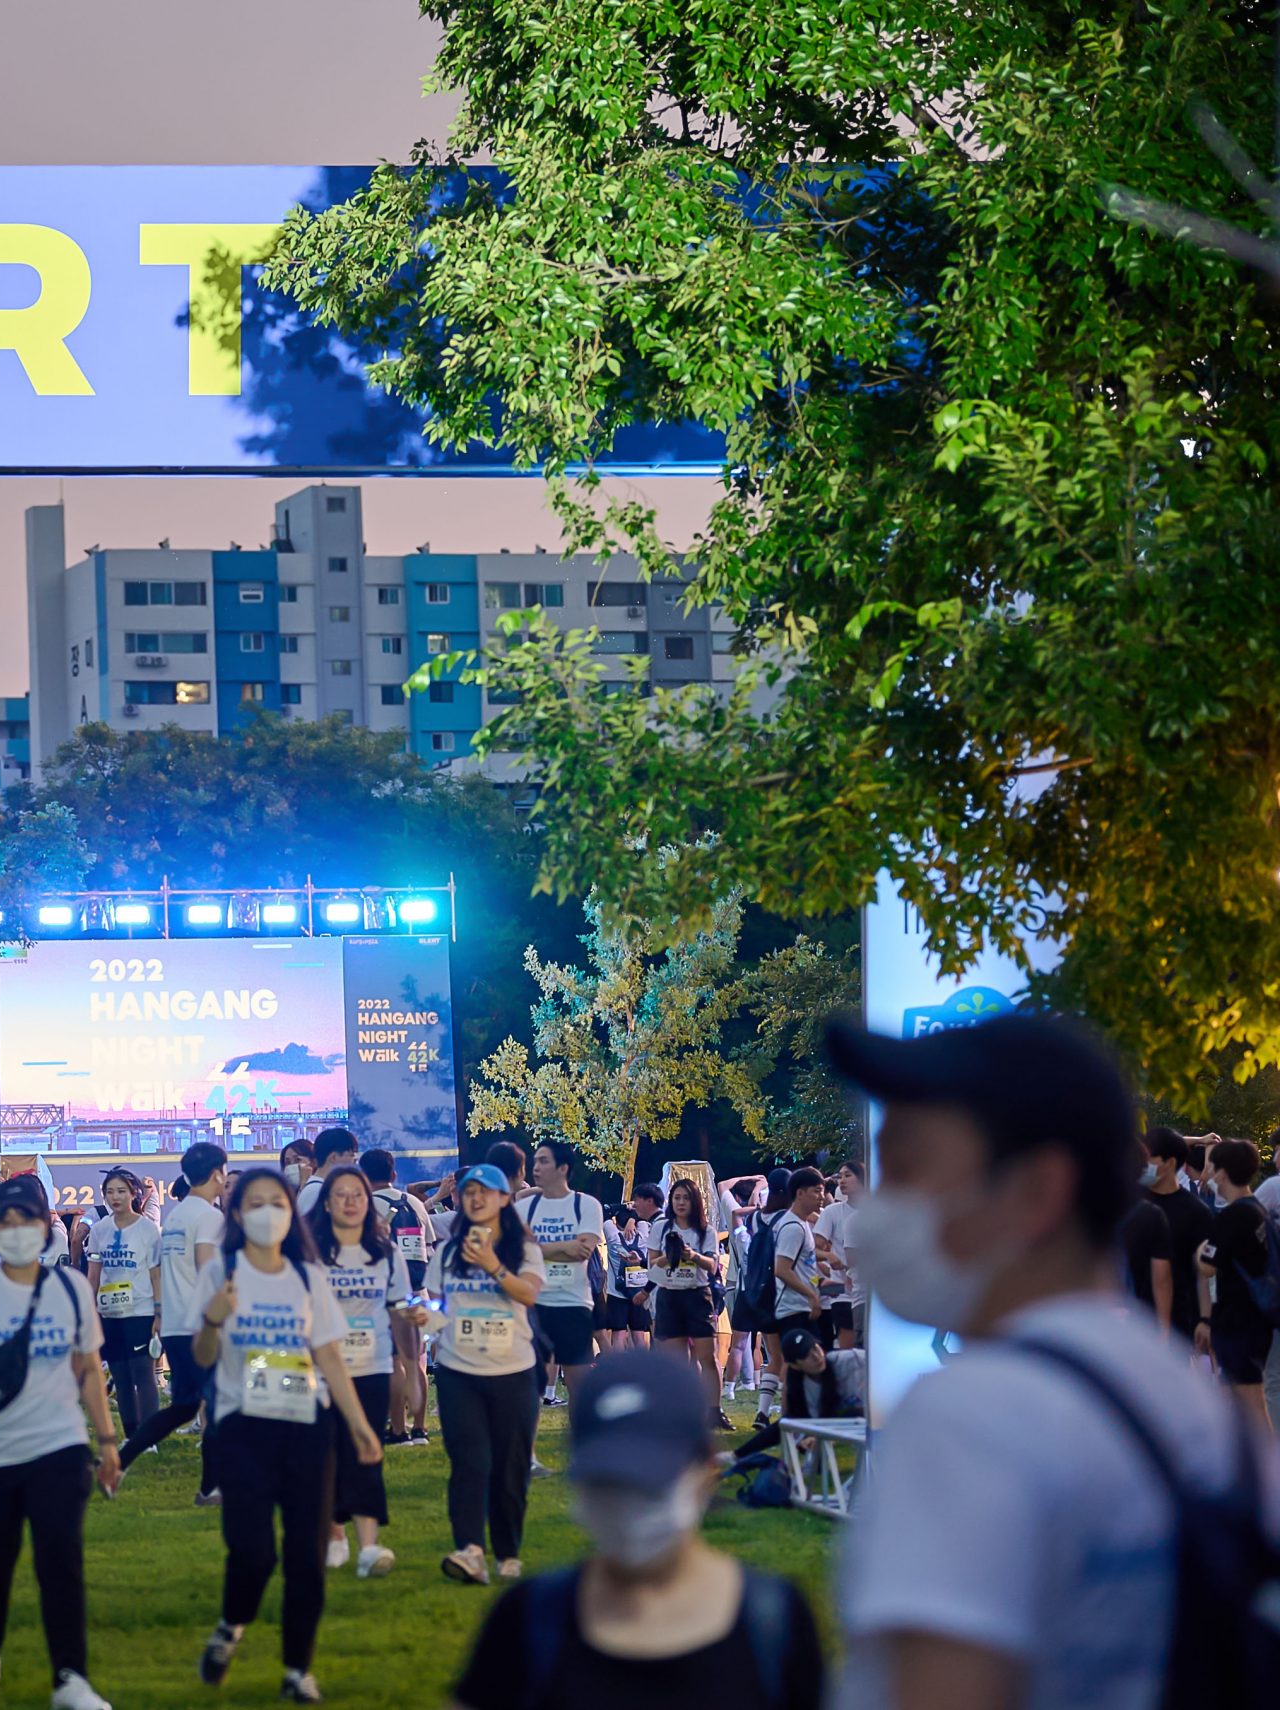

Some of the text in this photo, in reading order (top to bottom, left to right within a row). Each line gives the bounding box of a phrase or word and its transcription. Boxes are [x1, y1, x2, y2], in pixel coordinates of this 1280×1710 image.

[89, 958, 164, 982] 2022
[89, 988, 278, 1022] HANGANG
[358, 999, 390, 1009] 2022
[358, 1012, 439, 1025] HANGANG
[358, 1030, 408, 1043] NIGHT
[91, 1034, 205, 1066] NIGHT
[204, 1079, 281, 1114] 42K
[533, 1224, 574, 1233] NIGHT
[402, 1237, 410, 1247] C
[548, 1269, 572, 1277] 20:00
[328, 1276, 376, 1286] IGHT
[100, 1294, 130, 1305] C 20:00
[462, 1319, 473, 1335] B
